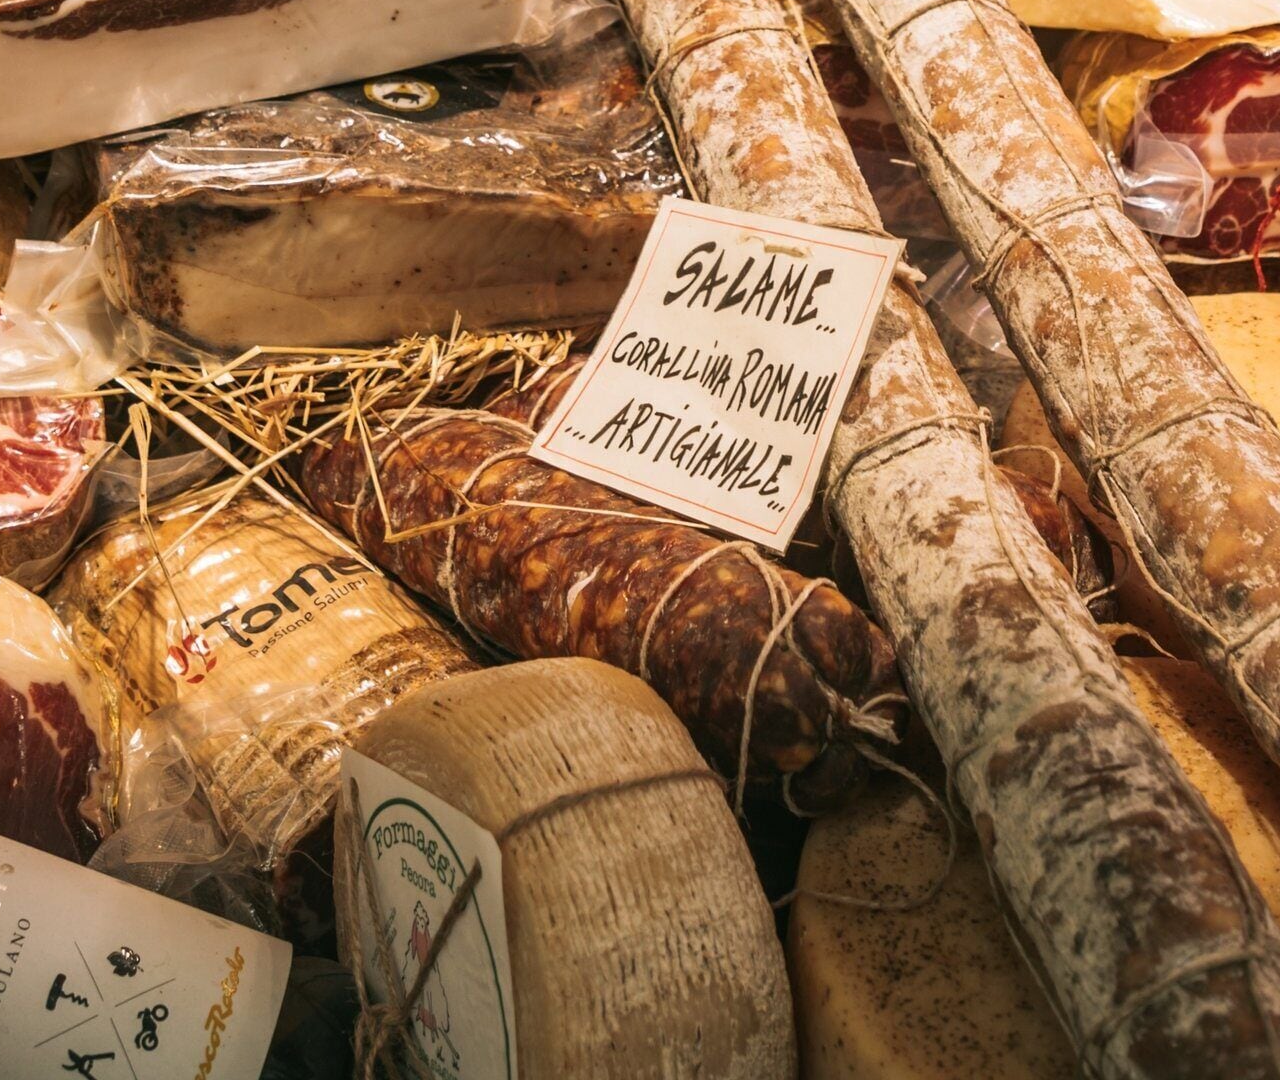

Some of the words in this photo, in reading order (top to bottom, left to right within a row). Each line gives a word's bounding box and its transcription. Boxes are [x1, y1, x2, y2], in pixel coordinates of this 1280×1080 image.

[726, 348, 838, 436] ROMANA
[247, 610, 315, 659] Passione
[312, 576, 370, 611] Salumi
[372, 821, 457, 895] Formaggi
[400, 856, 437, 899] Pecora
